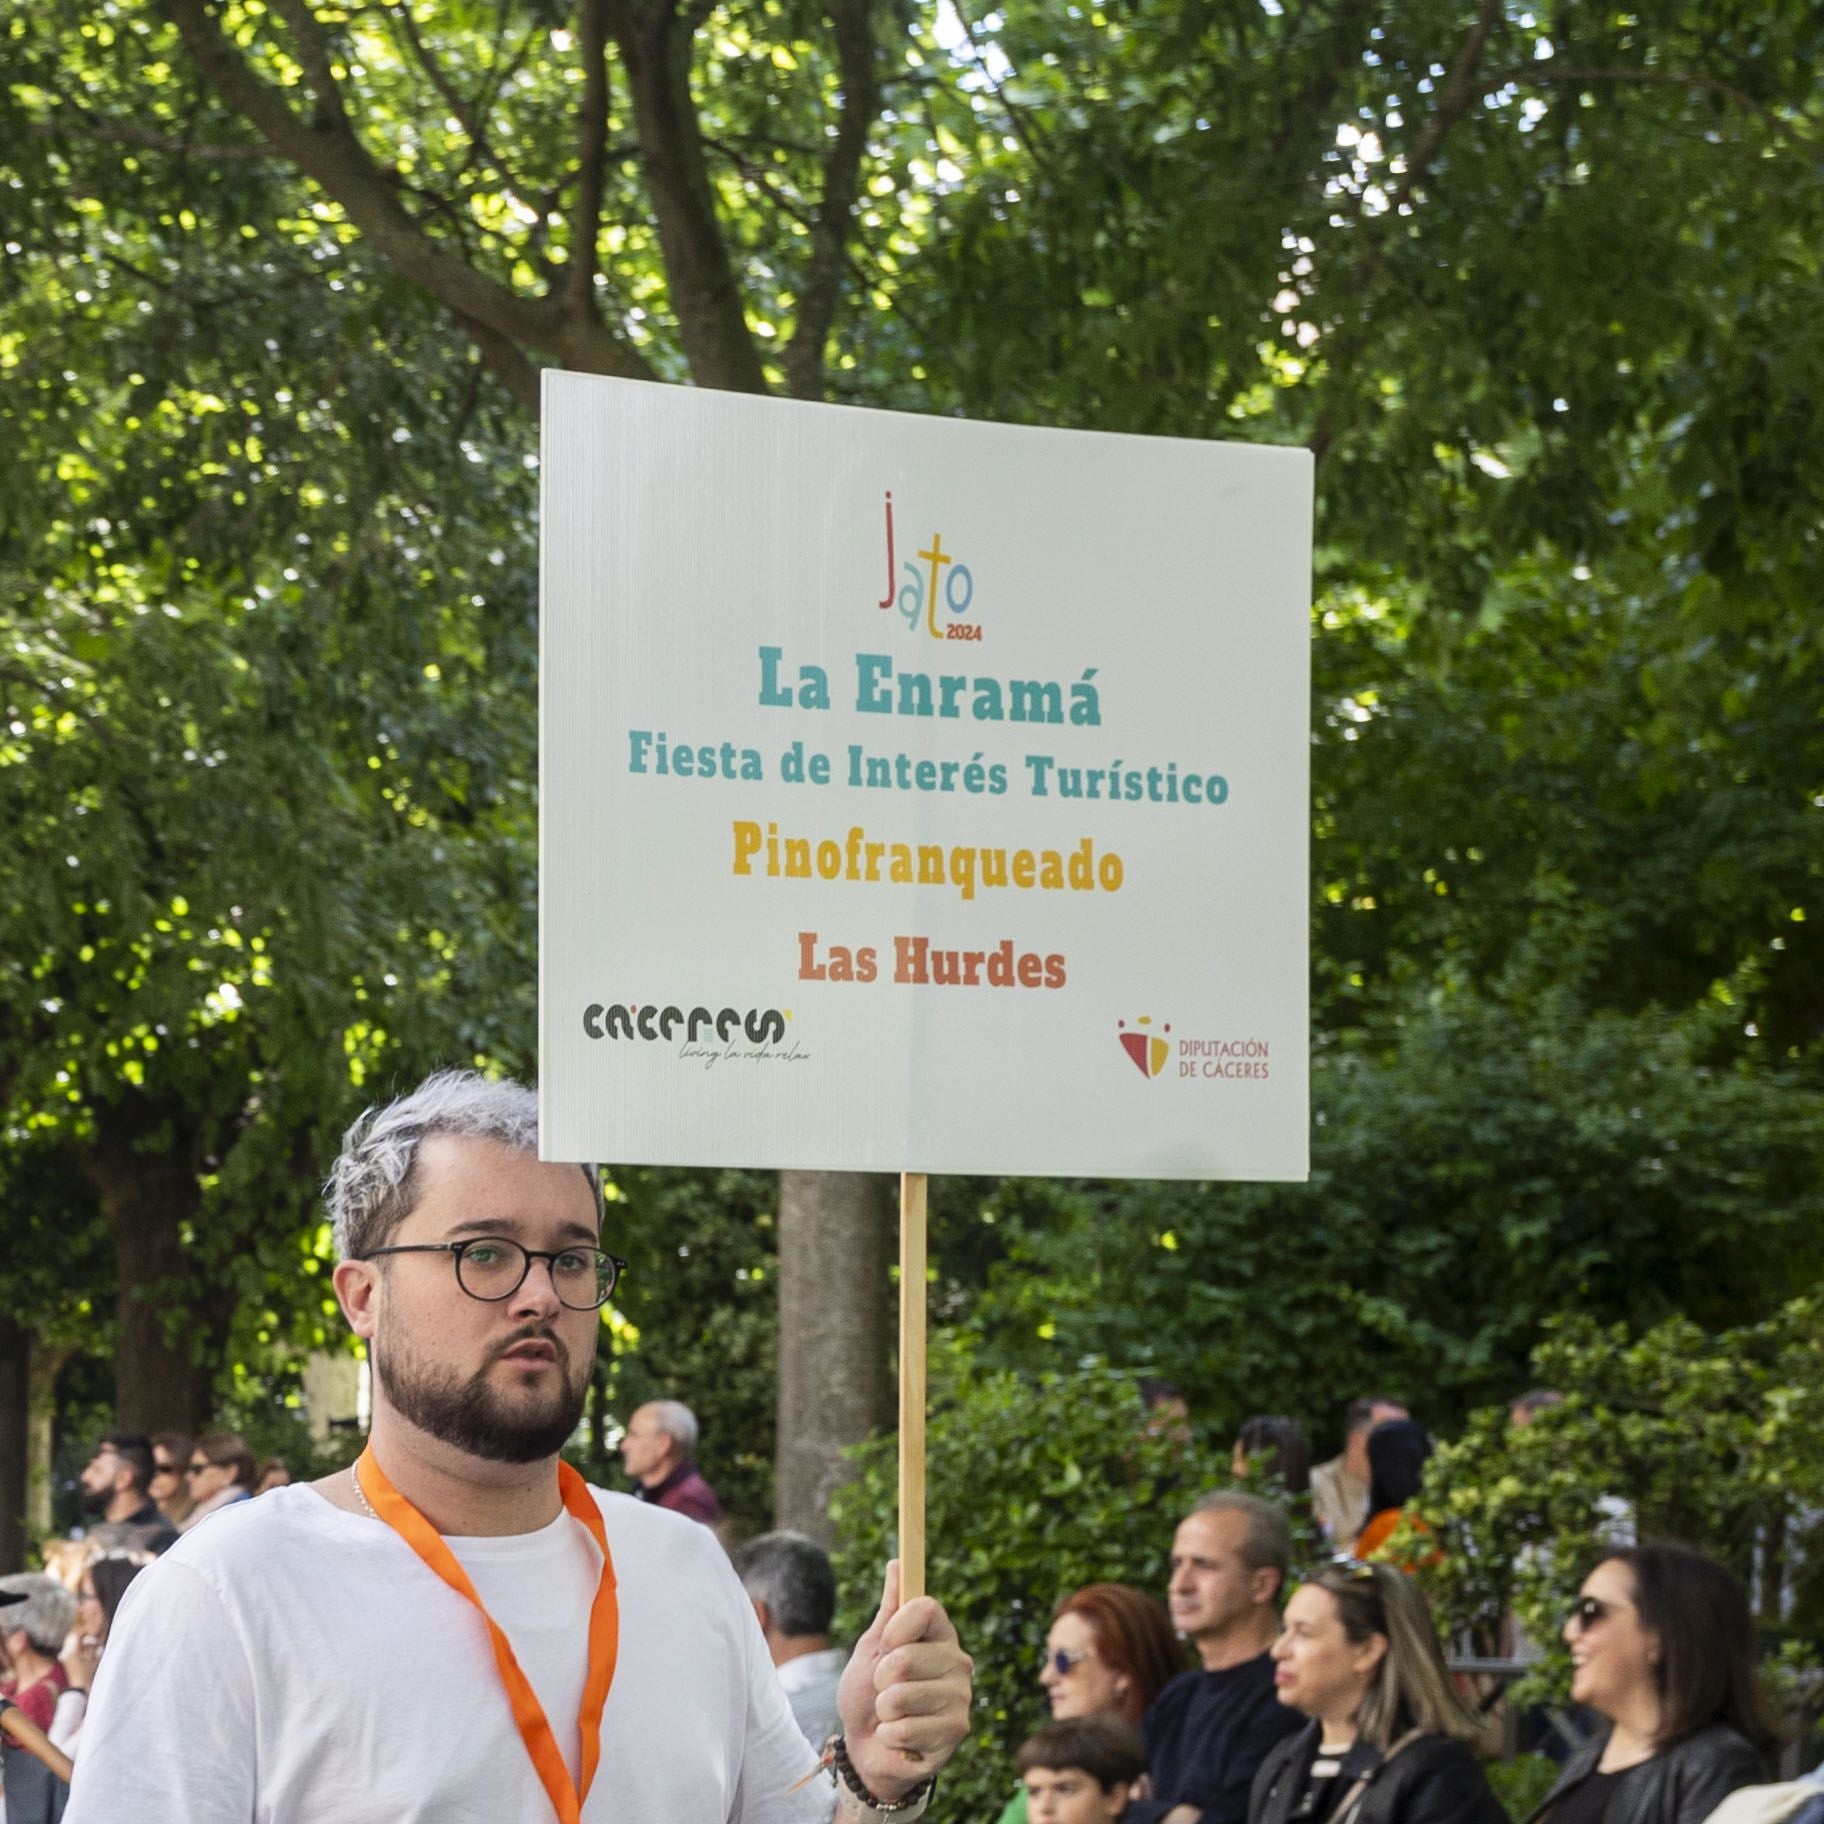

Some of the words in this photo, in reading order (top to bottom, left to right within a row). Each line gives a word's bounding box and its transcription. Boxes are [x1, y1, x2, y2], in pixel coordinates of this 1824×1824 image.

[945, 623, 984, 641] 2024
[758, 647, 830, 709] La
[856, 654, 1102, 726] Enramá
[628, 731, 763, 781] Fiesta
[780, 742, 831, 785] de
[848, 745, 1008, 795] Interés
[1025, 756, 1229, 805] Turístico
[732, 820, 1125, 901] Pinofranqueado
[798, 932, 878, 983] Las
[893, 936, 1067, 989] Hurdes
[679, 1041, 721, 1070] living
[723, 1040, 742, 1060] la
[743, 1042, 773, 1064] vida
[774, 1042, 811, 1062] relax
[1179, 1038, 1269, 1057] DIPUTACIÓN
[1179, 1060, 1197, 1078] DE
[1202, 1057, 1270, 1079] CÁCERES
